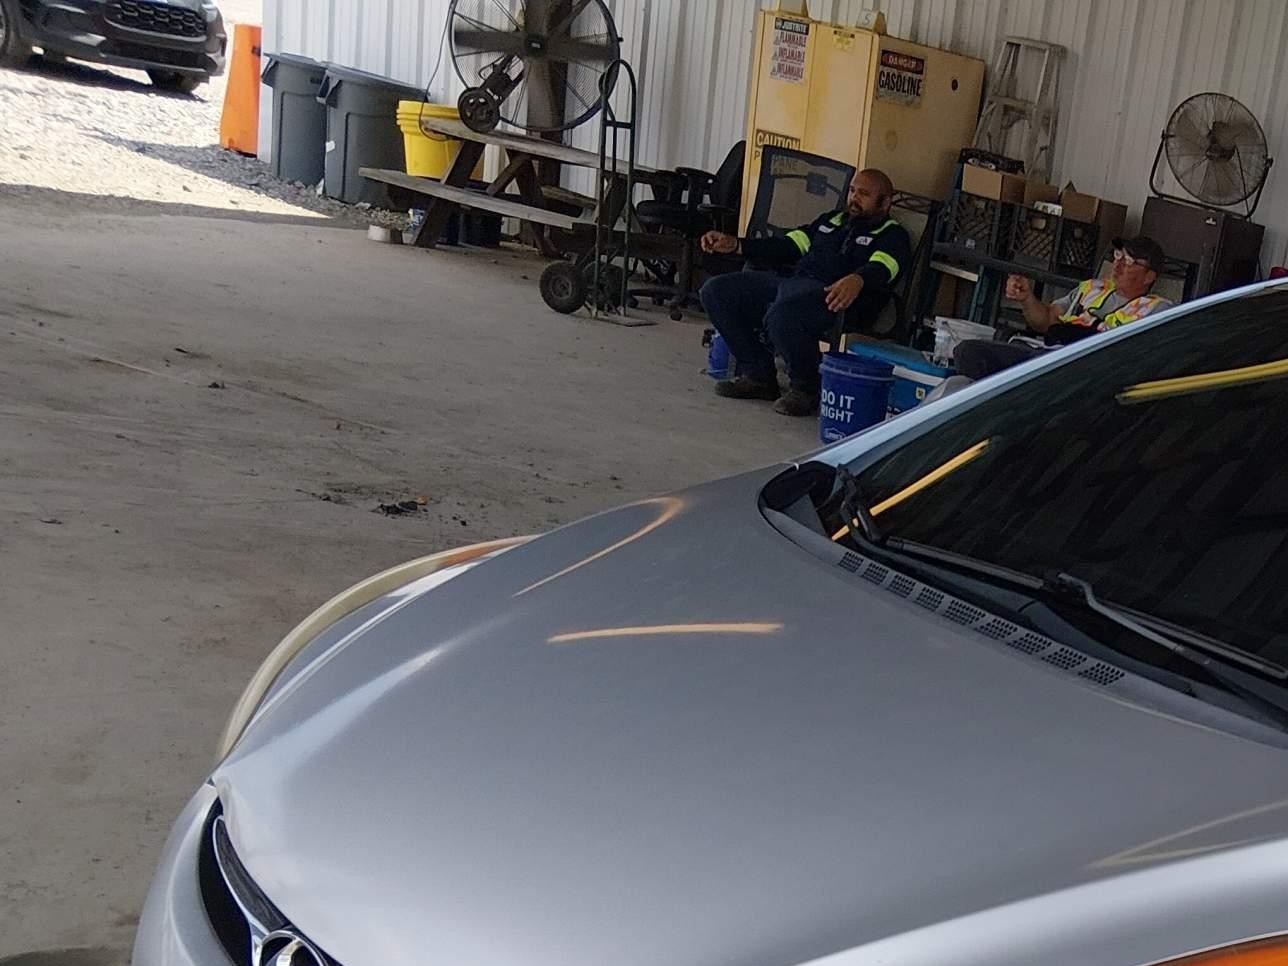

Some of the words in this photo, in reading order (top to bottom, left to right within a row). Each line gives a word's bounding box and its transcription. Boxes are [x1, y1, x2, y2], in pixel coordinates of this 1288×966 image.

[888, 55, 918, 69] DANGER
[878, 70, 923, 97] GASOLINE
[756, 132, 801, 151] CAUTION
[822, 389, 836, 405] DO
[840, 394, 855, 410] IT
[821, 404, 854, 423] RIGHT
